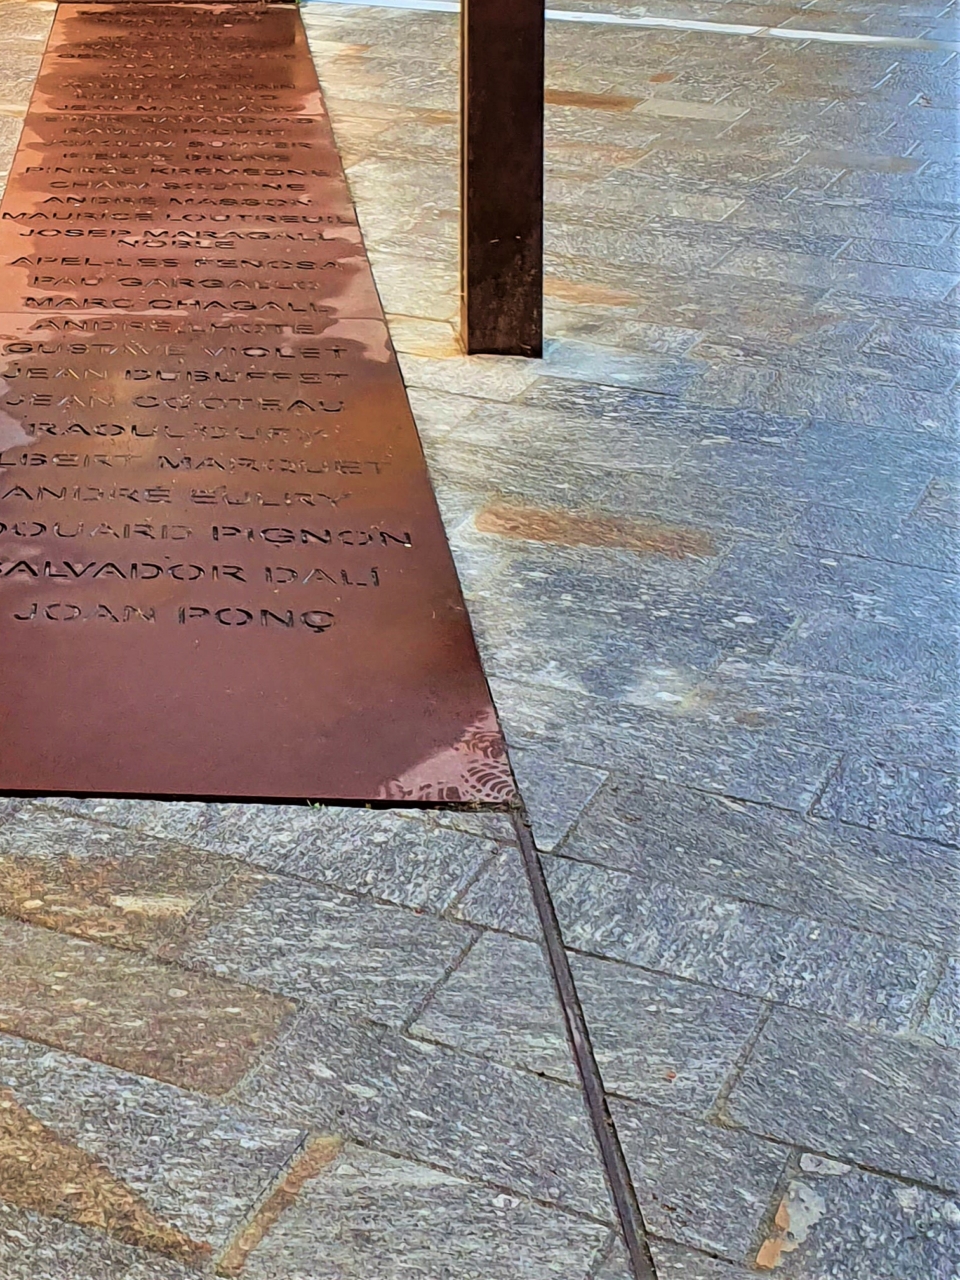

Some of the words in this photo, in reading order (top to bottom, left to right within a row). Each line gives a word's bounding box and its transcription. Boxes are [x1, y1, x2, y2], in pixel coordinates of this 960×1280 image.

[1, 212, 154, 221] MAURICE
[166, 213, 355, 224] LOUTREUIL
[19, 228, 131, 238] JOSEP
[143, 230, 336, 242] MARAGALL
[117, 239, 235, 249] NOBLE
[32, 275, 103, 287] PAU
[117, 277, 321, 290] GARGALLO
[22, 296, 136, 309] MARC
[148, 299, 330, 312] CHAGALL
[6, 342, 186, 356] GUSTAVE
[203, 345, 347, 359] VIOLET
[2, 368, 108, 379] JEAN
[124, 369, 349, 384] DUBUFFET
[5, 393, 115, 408] JEAN
[133, 395, 344, 412] COCTEAU
[27, 422, 185, 438] RAOUL
[157, 455, 390, 474] MARQUET
[1, 486, 171, 503] ANDRÉ
[211, 525, 413, 547] PIGNON
[13, 603, 156, 622] JOAN
[178, 606, 335, 633] PONÇ
